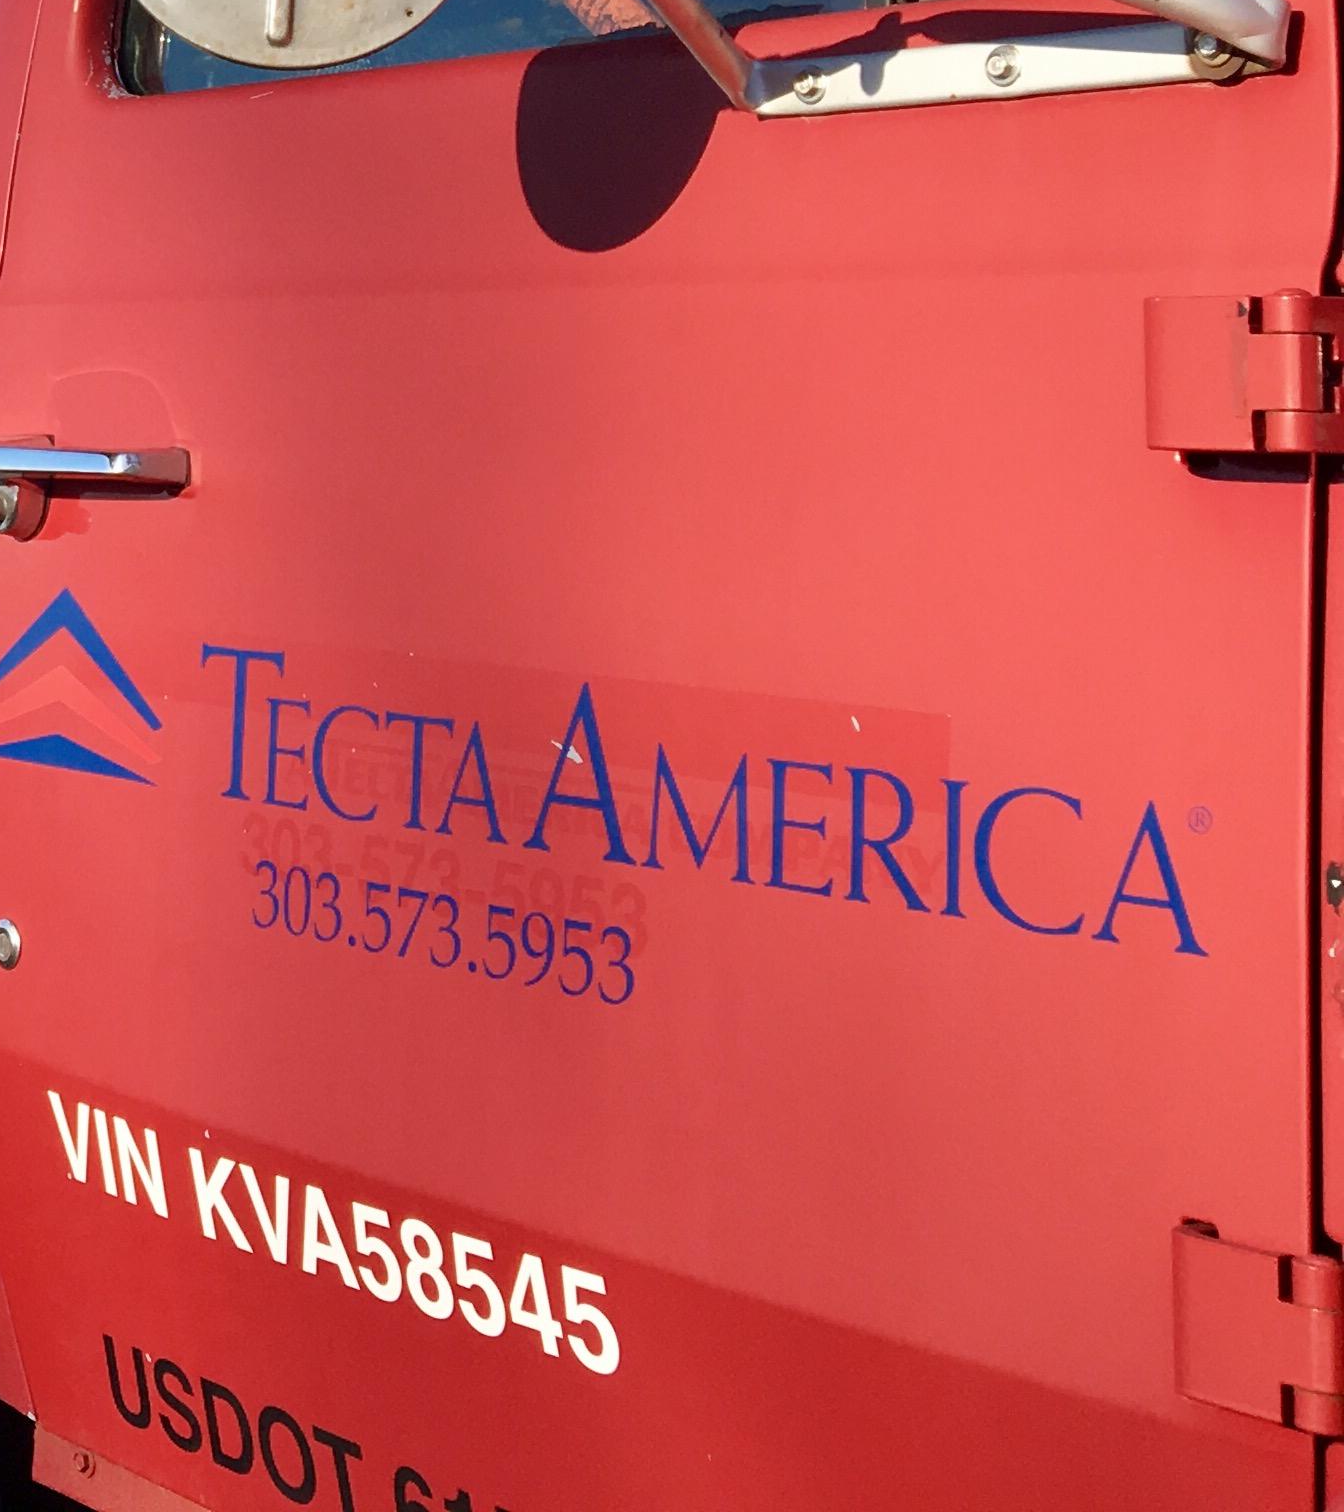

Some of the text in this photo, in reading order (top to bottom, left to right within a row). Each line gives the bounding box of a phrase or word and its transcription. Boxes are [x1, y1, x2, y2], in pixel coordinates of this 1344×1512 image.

[251, 859, 638, 1006] 303.573.5953
[47, 1090, 620, 1375] VIN KVA58545
[102, 1334, 363, 1512] USDOT
